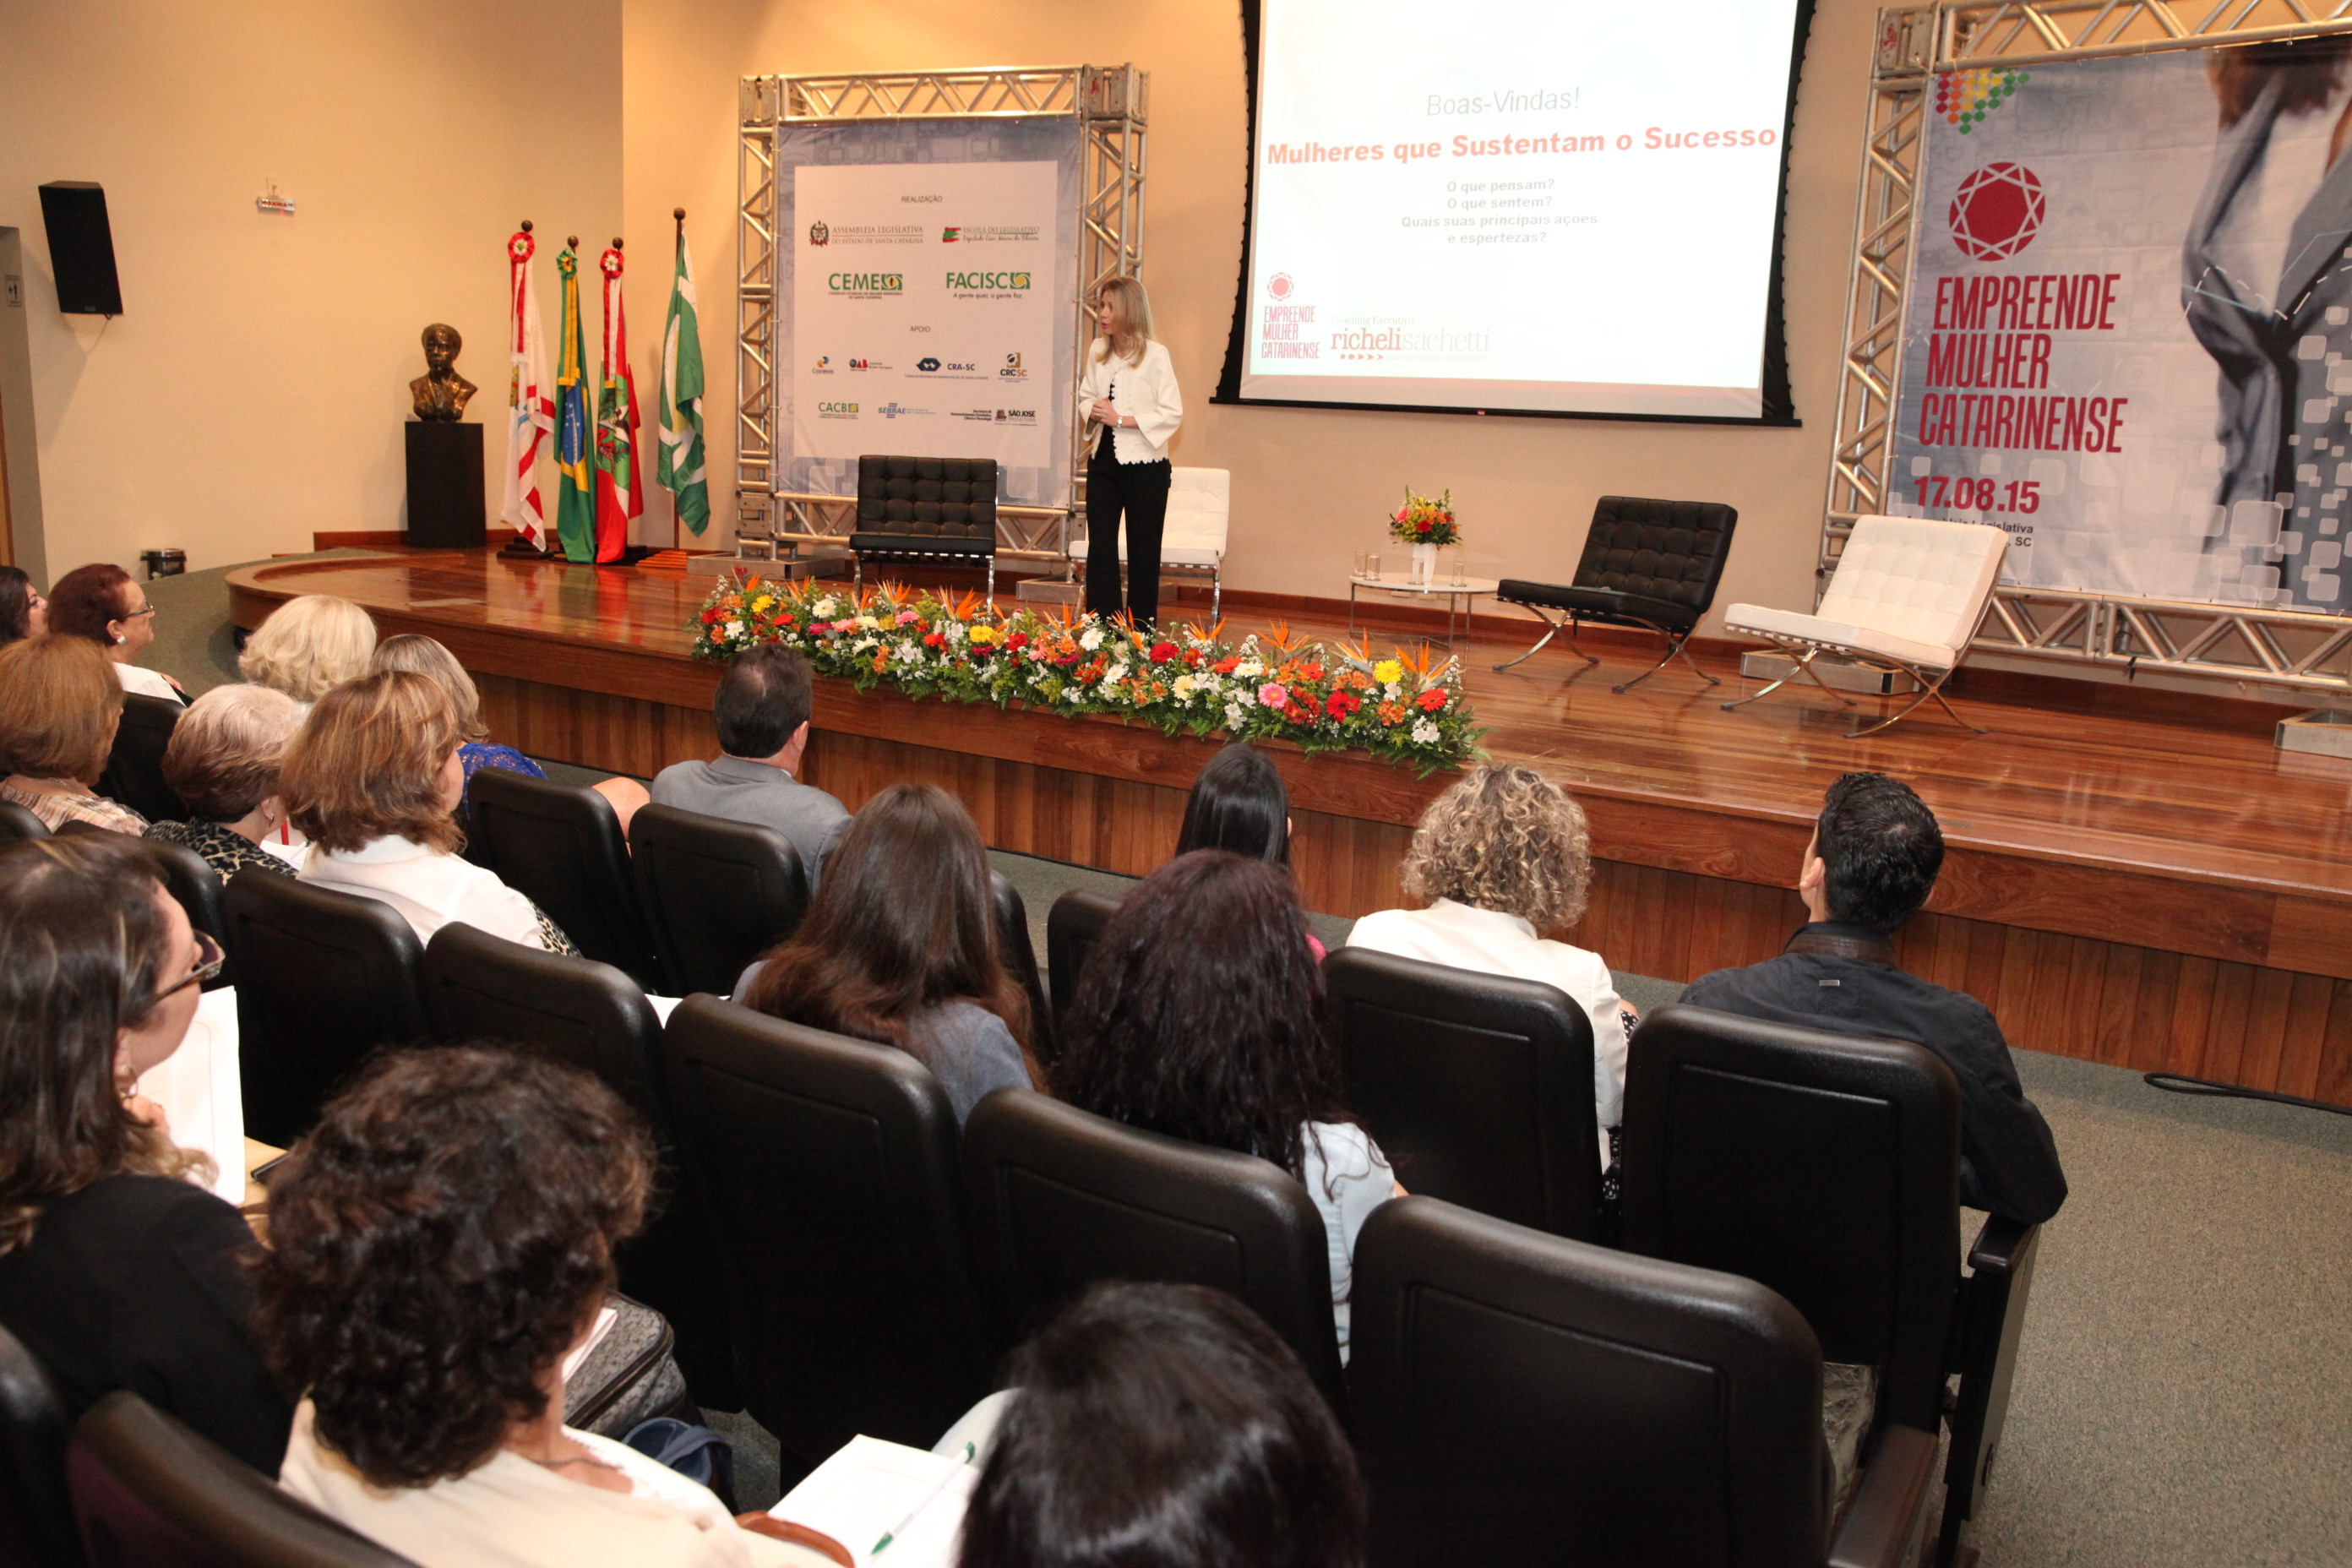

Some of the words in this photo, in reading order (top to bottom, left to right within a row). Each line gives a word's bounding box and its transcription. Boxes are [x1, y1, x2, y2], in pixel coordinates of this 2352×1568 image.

[1427, 86, 1580, 116] Boas-Vindas!
[1268, 140, 1385, 164] Mulheres
[1394, 140, 1443, 165] que
[1451, 132, 1605, 158] Sustentam
[1616, 133, 1632, 150] o
[1645, 126, 1776, 150] Sucesso
[1447, 180, 1457, 193] O
[1461, 181, 1486, 195] que
[1490, 178, 1554, 194] pensam?
[1447, 198, 1457, 210] O
[1461, 199, 1486, 212] que
[1490, 196, 1552, 209] sentem?
[1402, 215, 1440, 228] Quais
[1444, 216, 1476, 226] suas
[1480, 214, 1550, 229] principais
[1554, 214, 1598, 228] ações
[1448, 234, 1456, 243] e
[1460, 231, 1546, 246] espertezas?
[1934, 274, 2121, 329] EMPREENDE
[1264, 306, 1315, 324] EMPREENDE
[1331, 315, 1370, 325] Coaching
[1373, 314, 1413, 325] Executivo
[1263, 324, 1298, 340] MULHER
[1261, 341, 1320, 359] CATARINENSE
[849, 358, 868, 368] OAB
[1926, 333, 2050, 389] MULHER
[1008, 409, 1020, 417] SÃO
[1919, 393, 2128, 453] CATARINENSE
[1914, 476, 2040, 514] 17.08.15
[1973, 520, 2034, 534] slativa
[2015, 536, 2031, 547] SC
